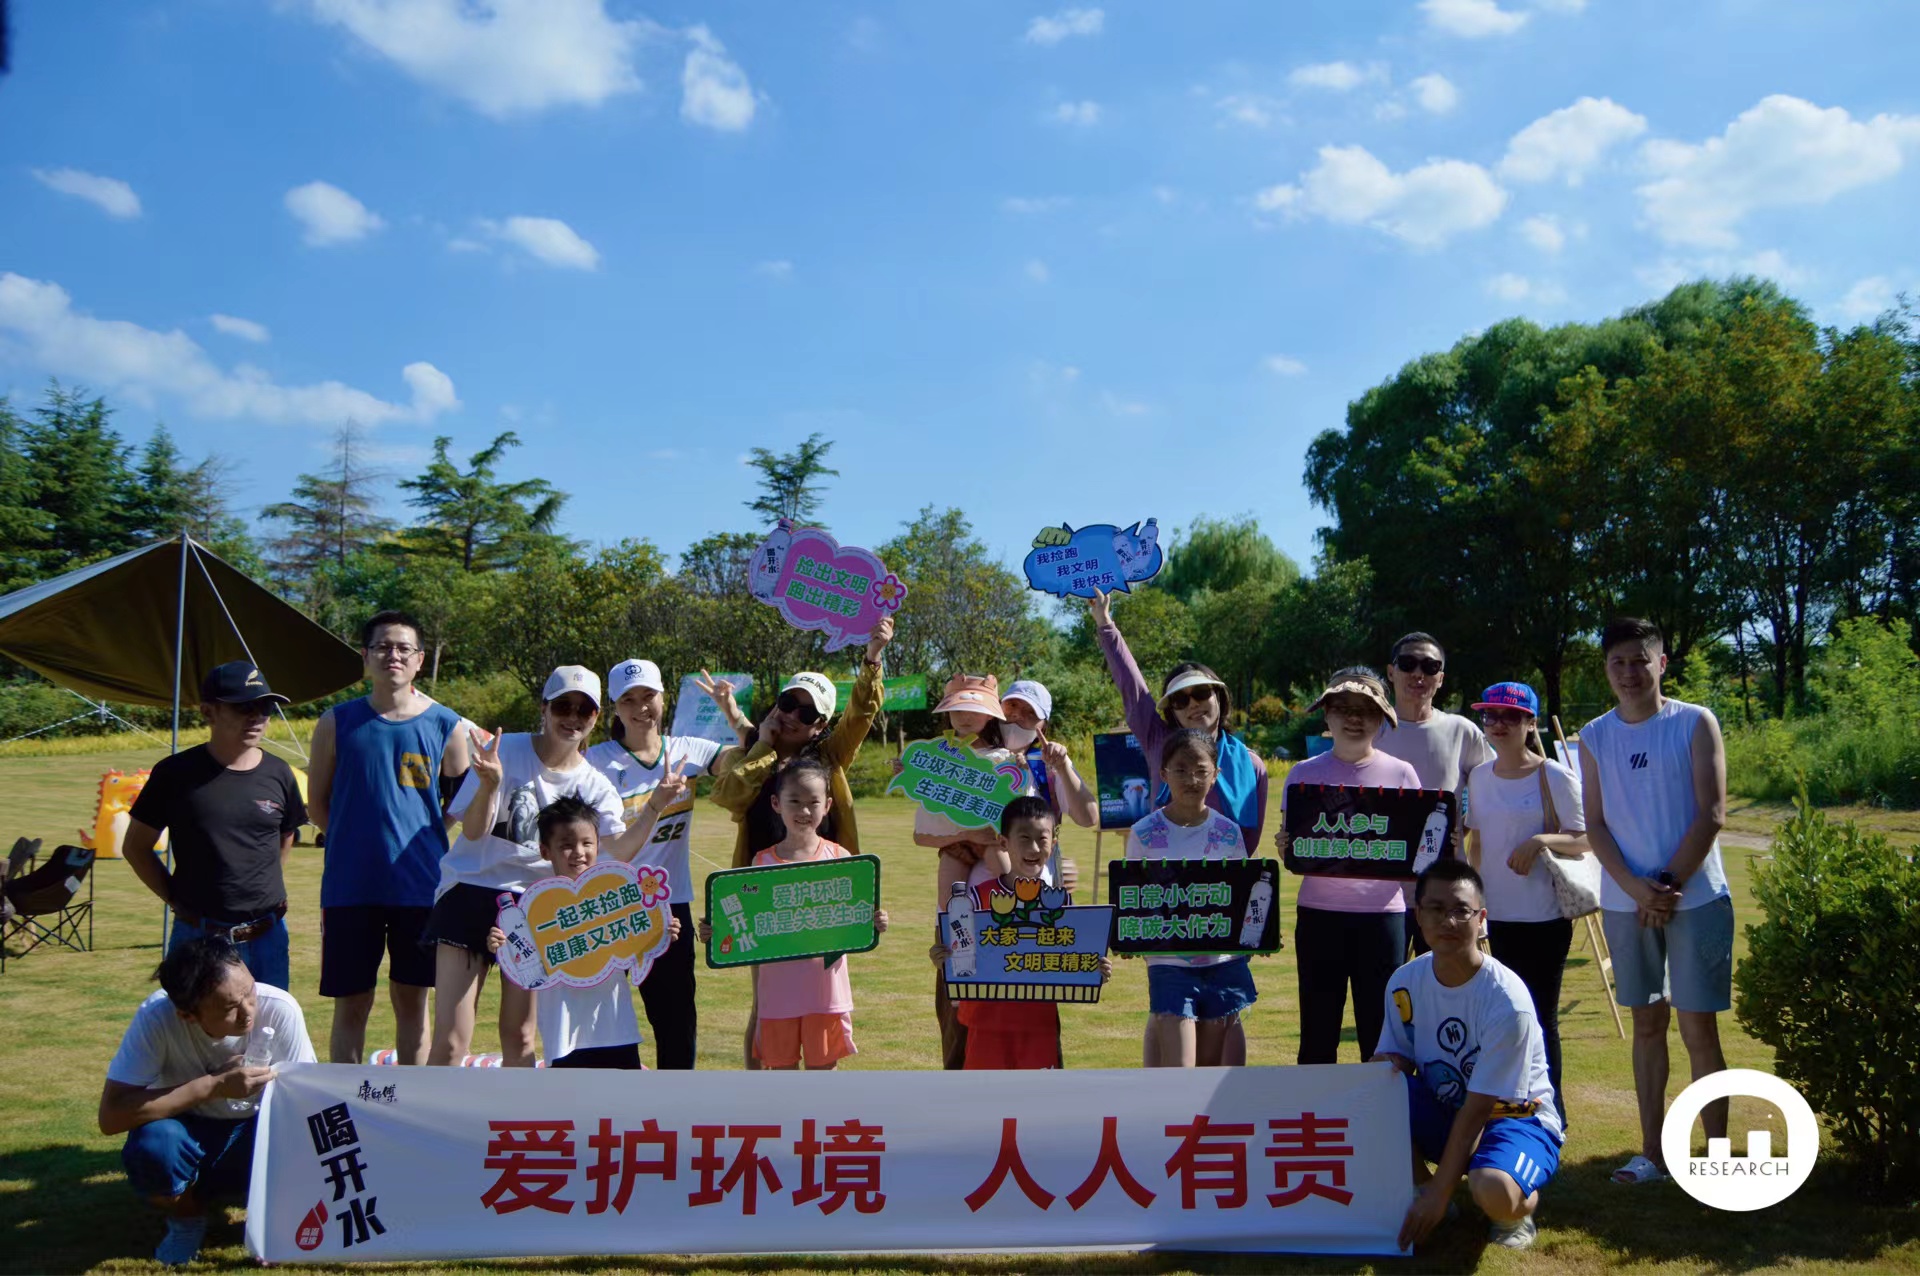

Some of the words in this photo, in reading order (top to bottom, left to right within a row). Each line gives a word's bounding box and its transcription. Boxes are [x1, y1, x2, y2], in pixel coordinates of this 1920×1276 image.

[1036, 547, 1078, 565] 我捡跑
[1057, 559, 1098, 577] 我文明
[794, 555, 870, 595] 捡出文明
[1072, 572, 1115, 590] 我快乐
[785, 578, 861, 618] 跑出精彩
[800, 676, 827, 694] CELINE
[910, 750, 998, 793] 垃圾不落地
[914, 778, 1005, 822] 生活更美丽
[651, 821, 687, 844] 32
[1312, 812, 1389, 835] 人人参与
[1293, 837, 1407, 861] 创建绿色家园
[536, 882, 642, 932] 一起来捡跑
[773, 877, 853, 909] 爱护环境
[1119, 882, 1232, 910] 日常小行动
[720, 893, 759, 953] 喝开水
[754, 900, 873, 936] 就是关爱生命
[1118, 913, 1232, 941] 降碳大作为
[545, 910, 651, 967] 健康又环保
[979, 926, 1075, 947] 大家一起来
[1004, 951, 1099, 973] 文明更精彩
[307, 1101, 387, 1249] 喝开水
[480, 1117, 887, 1216] 爱护环境
[963, 1111, 1354, 1214] 人人有责
